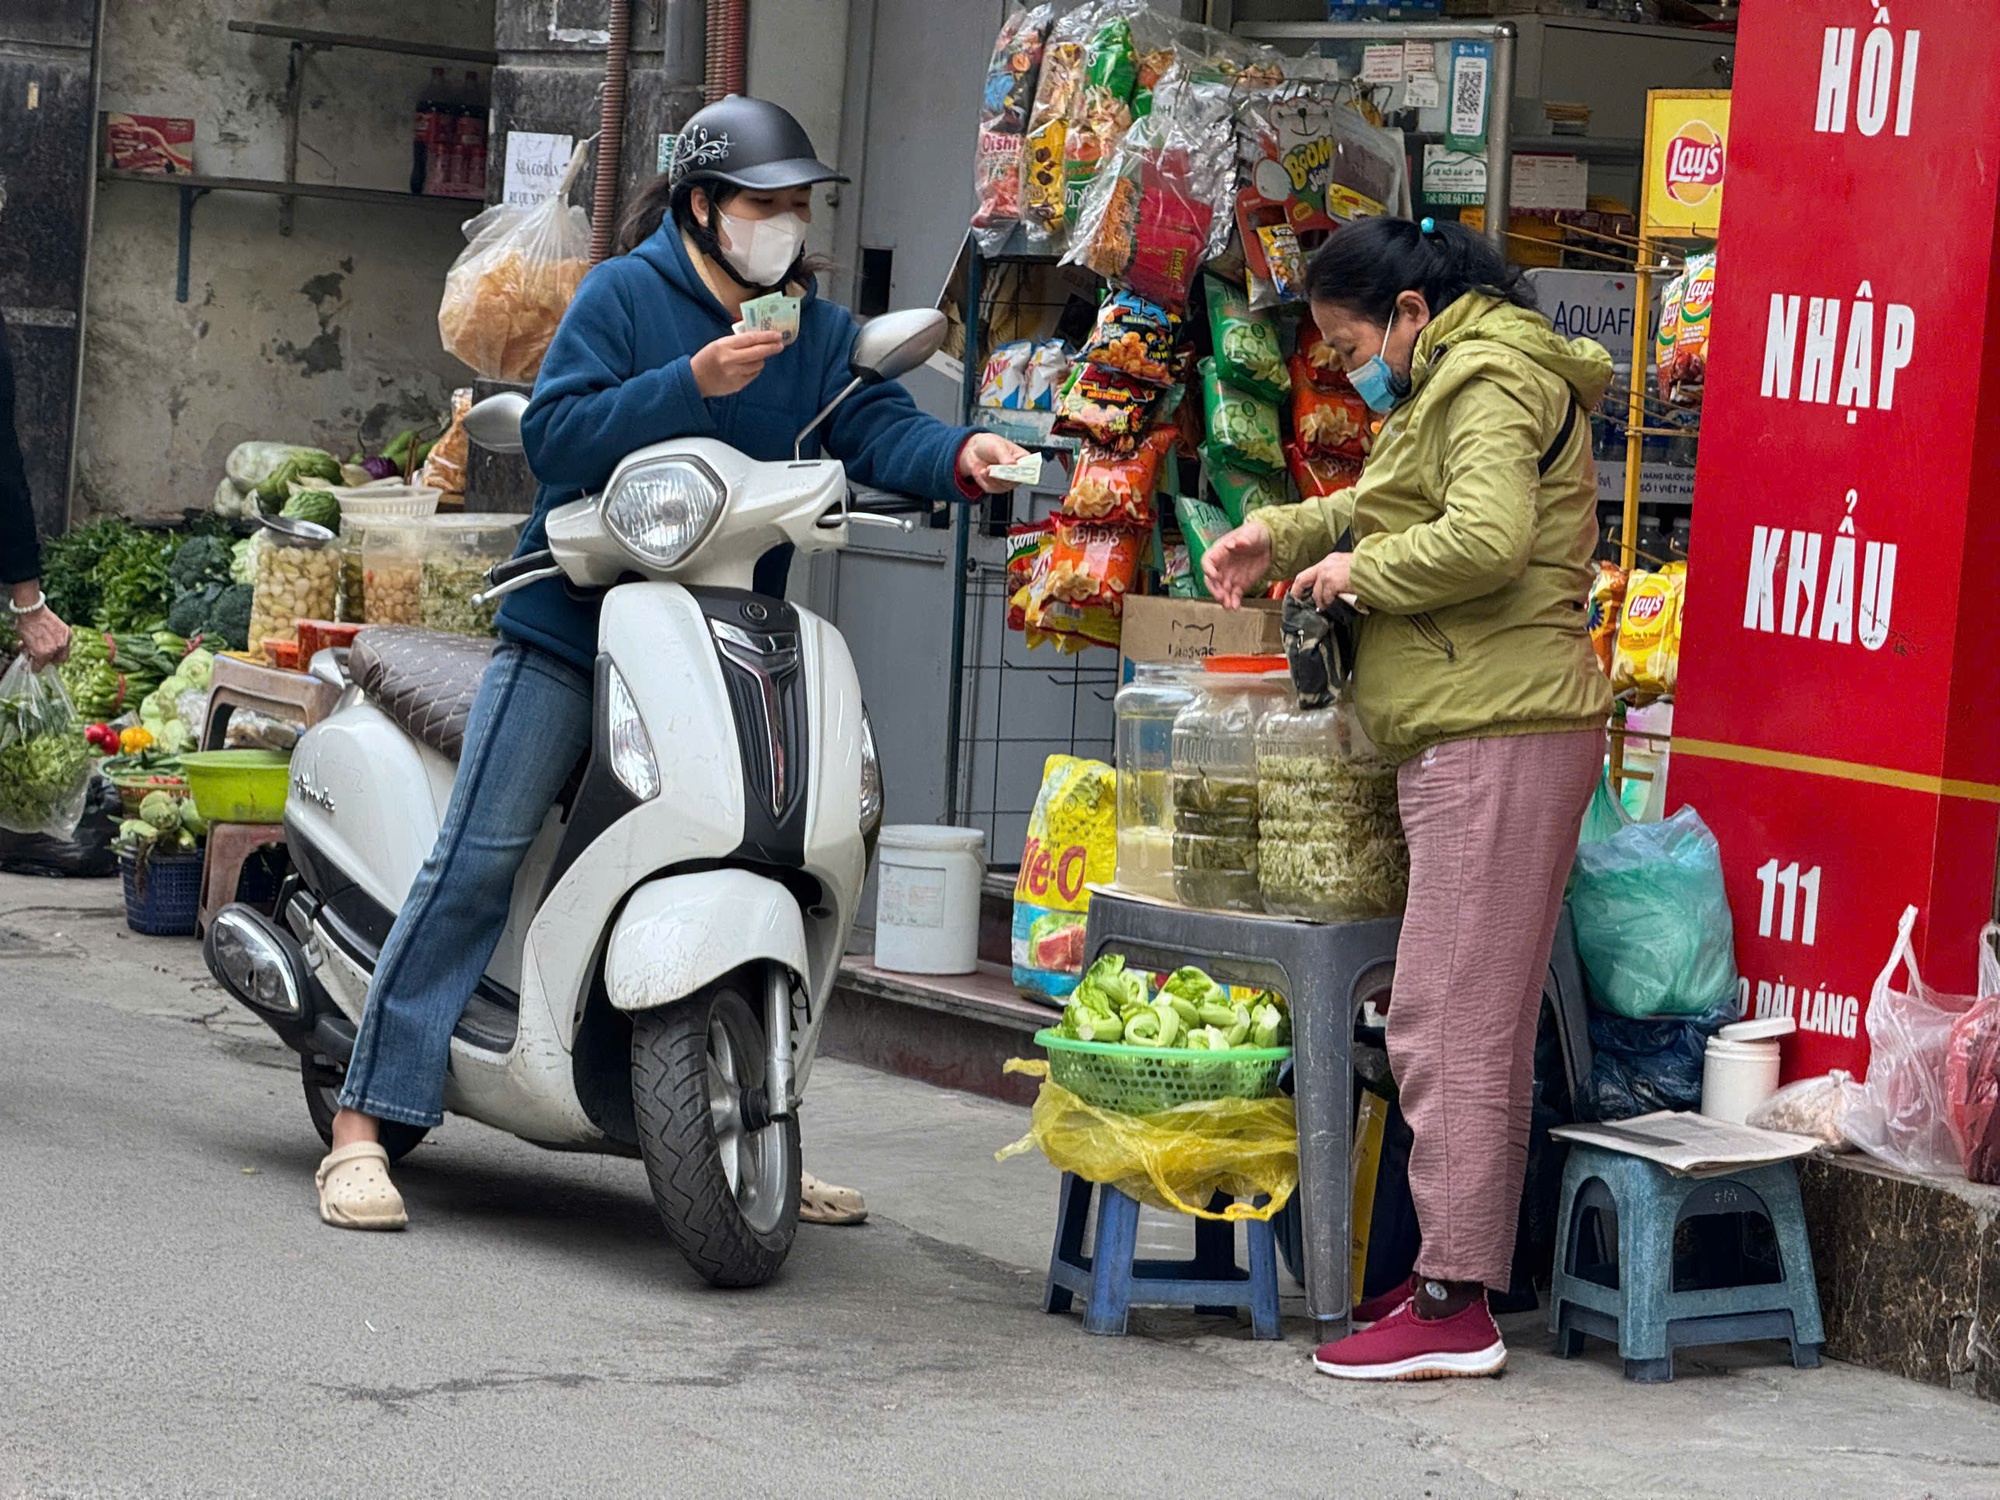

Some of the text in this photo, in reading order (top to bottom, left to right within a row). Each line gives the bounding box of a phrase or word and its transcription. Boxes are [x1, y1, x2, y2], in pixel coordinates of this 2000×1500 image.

[1815, 0, 1920, 136] HỒI
[983, 133, 1018, 153] Oishi
[1669, 138, 1721, 182] Lay's
[1553, 300, 1661, 342] AQUAFI
[1760, 281, 1916, 425] NHẬP
[1743, 488, 1898, 651] KHẨU
[1756, 858, 1821, 946] 111
[1799, 981, 1859, 1039] LÁNG
